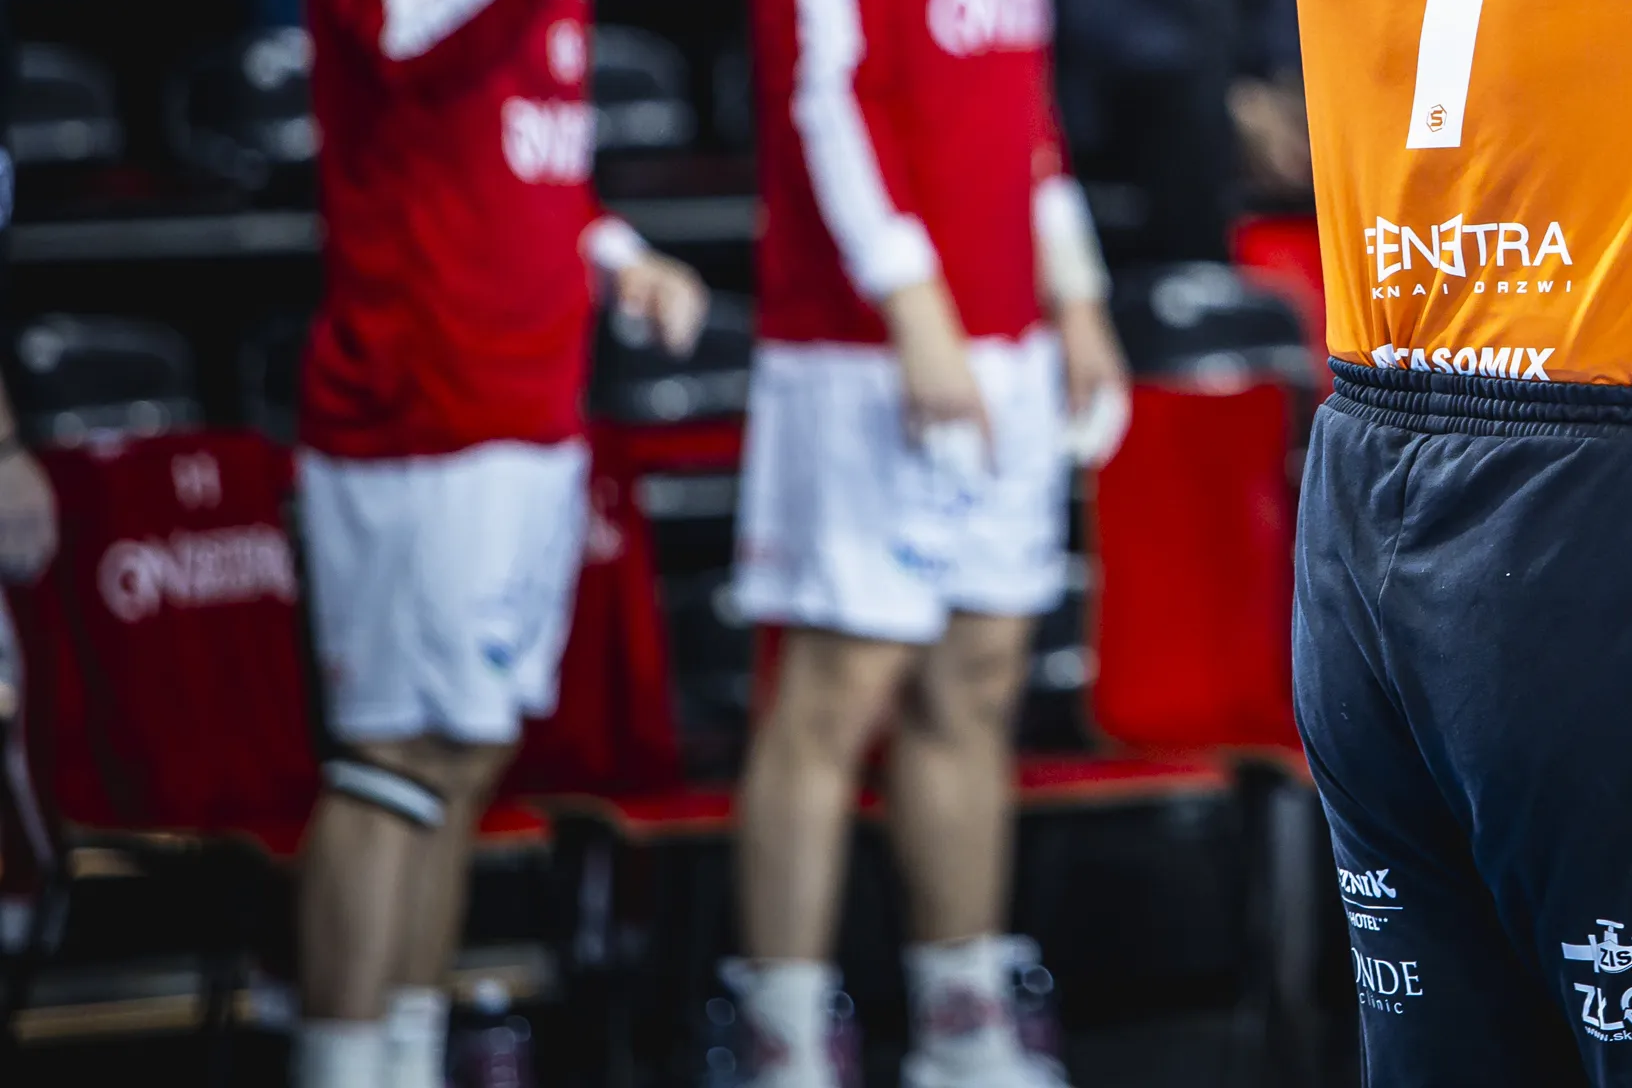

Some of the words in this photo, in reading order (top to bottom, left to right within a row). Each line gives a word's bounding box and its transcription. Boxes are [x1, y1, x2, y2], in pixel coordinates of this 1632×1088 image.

[1371, 283, 1426, 300] KNA
[1337, 867, 1397, 899] ZNIK
[1600, 948, 1632, 968] ZIS
